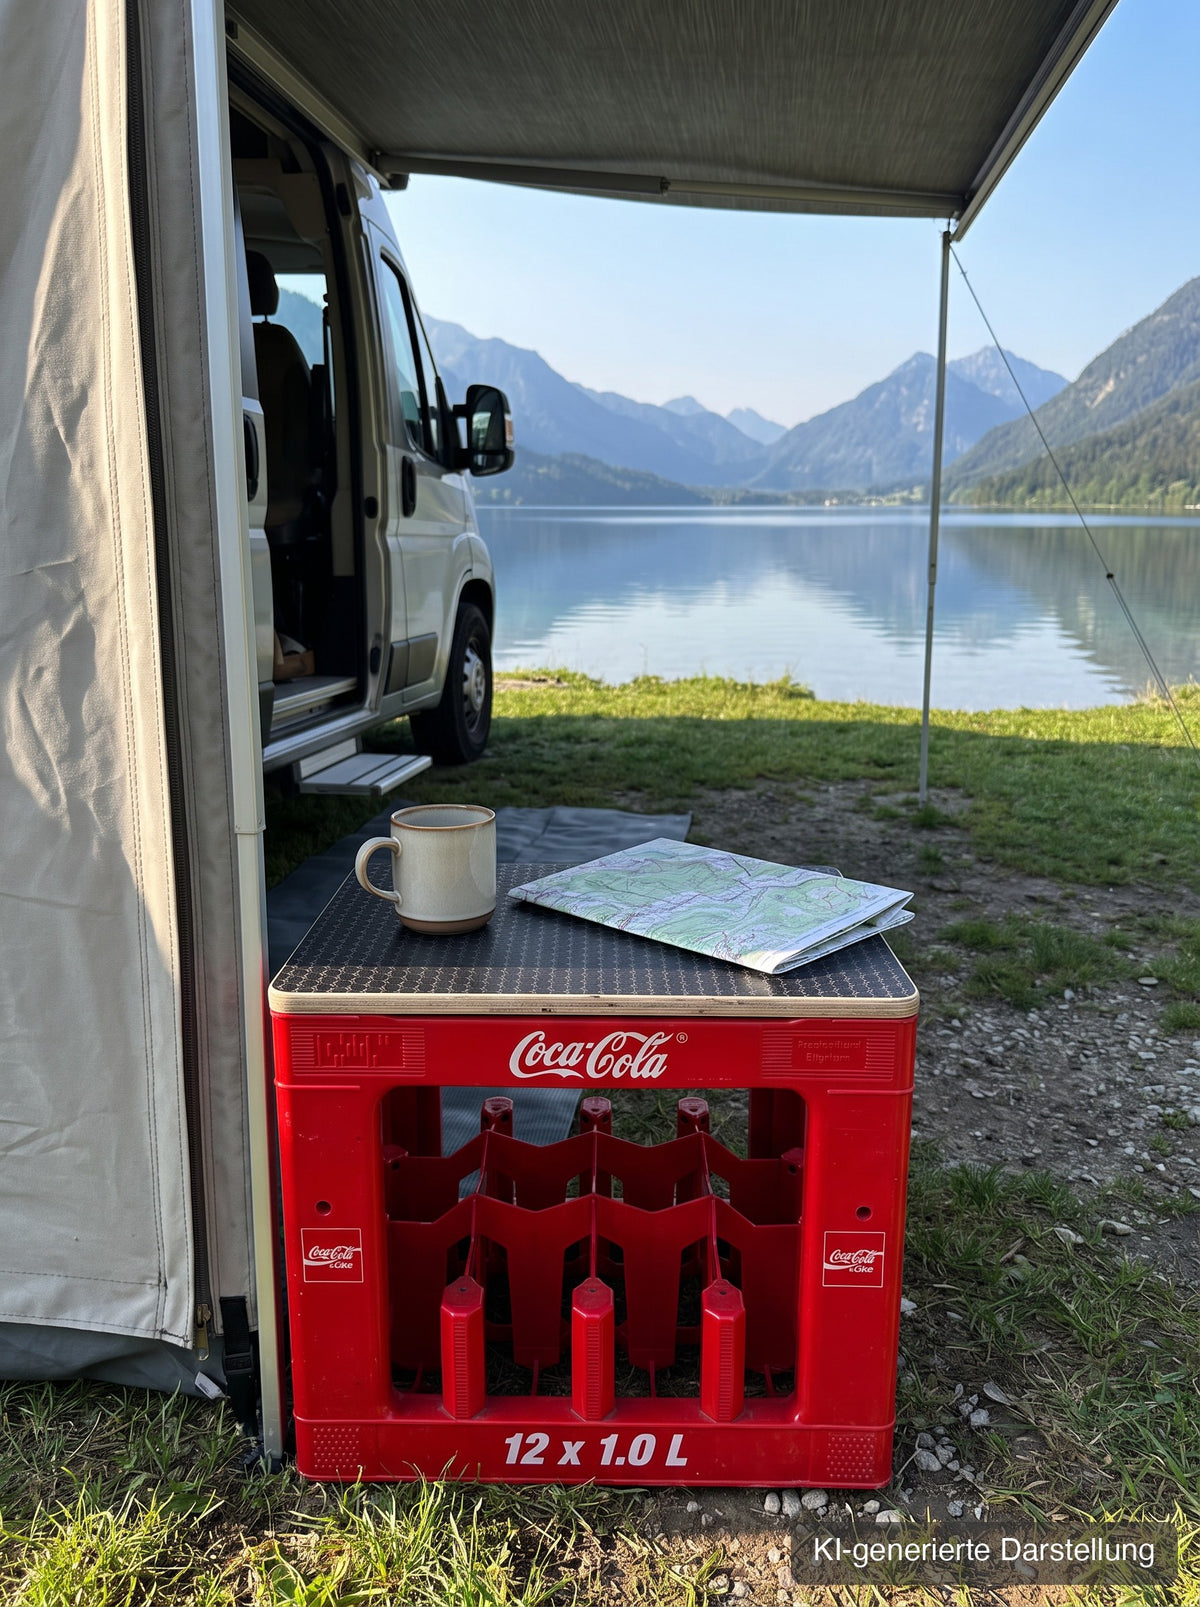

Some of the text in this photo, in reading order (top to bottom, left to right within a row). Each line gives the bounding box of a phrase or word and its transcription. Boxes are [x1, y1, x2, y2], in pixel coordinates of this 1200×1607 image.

[509, 1030, 674, 1079] Coca-Cola
[308, 1245, 355, 1260] Coca-Cola
[829, 1249, 876, 1264] Coca-Cola
[505, 1432, 688, 1467] 12 x 1.0 L
